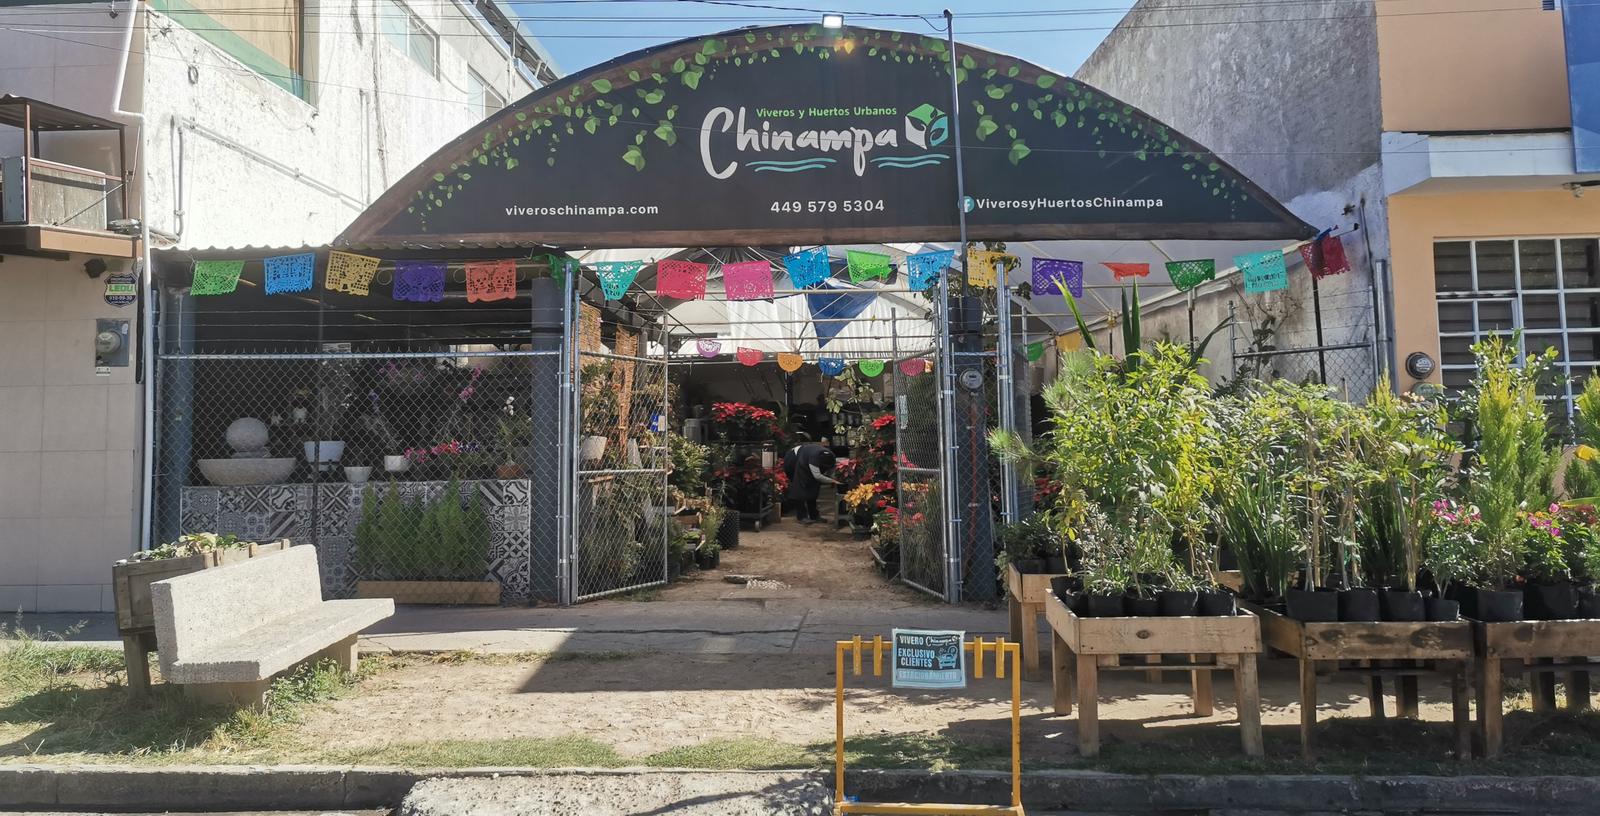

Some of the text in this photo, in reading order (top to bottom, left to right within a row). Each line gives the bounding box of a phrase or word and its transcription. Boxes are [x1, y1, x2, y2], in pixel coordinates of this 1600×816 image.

[756, 106, 897, 119] Viveros y Huertos Urbanos
[700, 106, 898, 179] Chinampa
[505, 204, 659, 216] viveroschinampa.com
[770, 199, 885, 213] 449 579 5304
[976, 197, 1164, 211] ViverosyHuertosChinampa
[899, 635, 924, 646] VIVERO
[897, 647, 935, 659] EXCLUSIVO
[900, 656, 933, 668] CLIENTES
